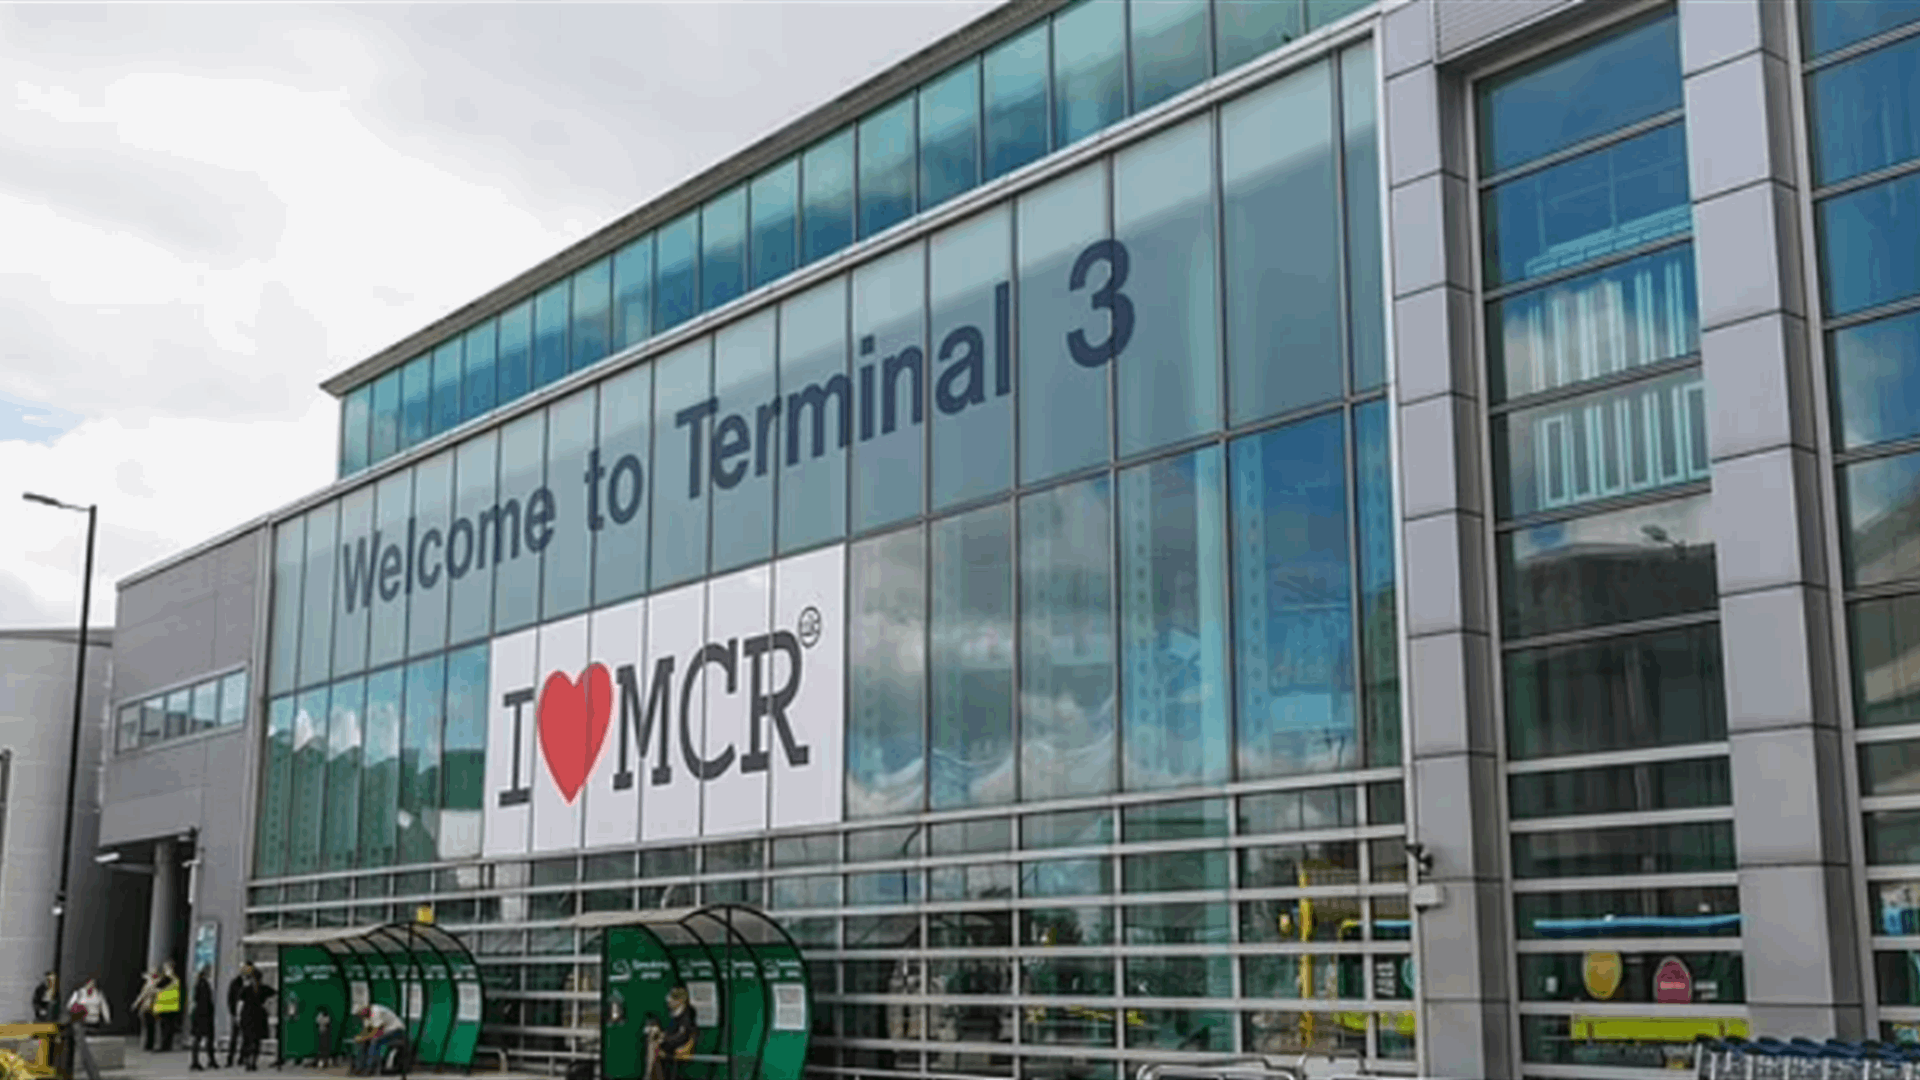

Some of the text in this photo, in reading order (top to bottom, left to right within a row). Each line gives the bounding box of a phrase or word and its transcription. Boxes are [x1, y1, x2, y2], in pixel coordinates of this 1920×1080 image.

[342, 239, 1136, 614] Welcome to Terminal 3
[498, 629, 809, 808] I MCR
